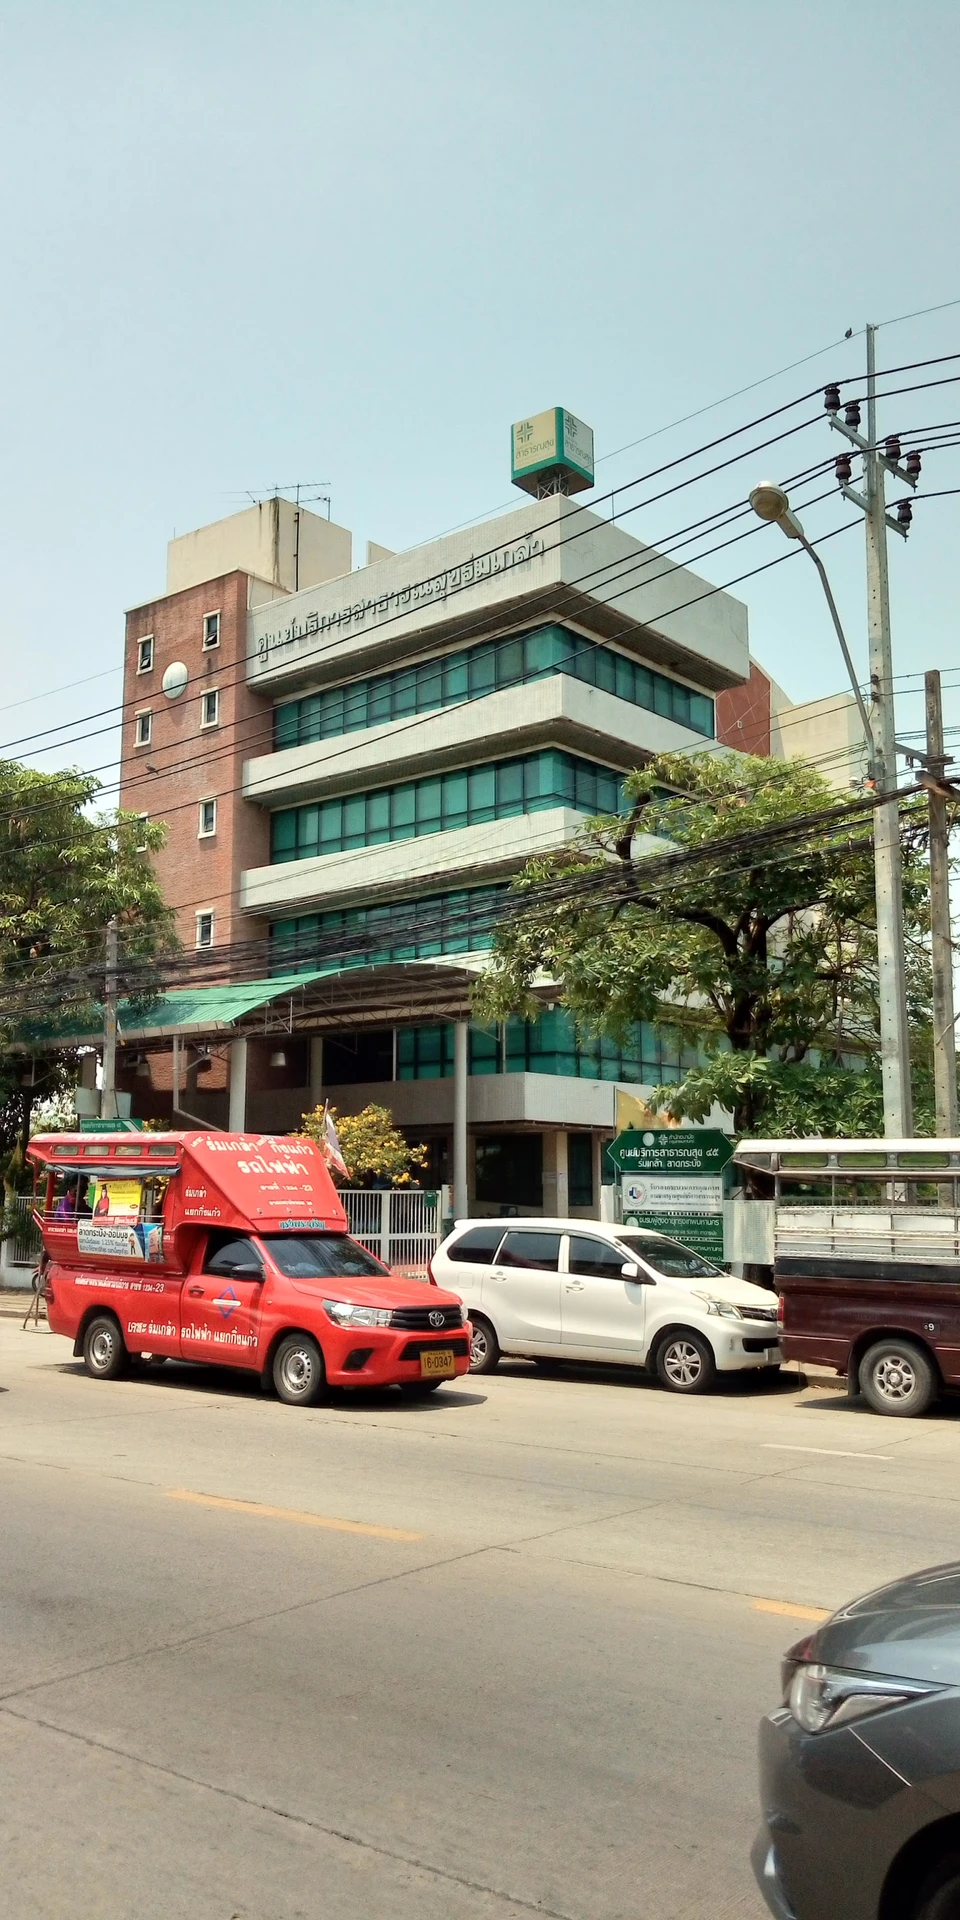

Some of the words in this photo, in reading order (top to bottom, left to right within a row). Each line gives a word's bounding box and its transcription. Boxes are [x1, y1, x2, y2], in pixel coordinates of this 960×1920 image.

[620, 1148, 703, 1159] ศูนย์บริการสาธารณสุข
[706, 1149, 720, 1157] ๔๕
[238, 1155, 309, 1175] รถไฟฟ้า
[638, 1159, 663, 1168] ร่มเกล้า
[668, 1159, 702, 1168] ลาดกระบัง
[149, 1320, 176, 1337] ร่มเกล้า
[181, 1323, 212, 1341] รถไฟฟ้า
[214, 1326, 259, 1348] แยกกิ่งแก้ว
[424, 1356, 452, 1369] 16-0347
